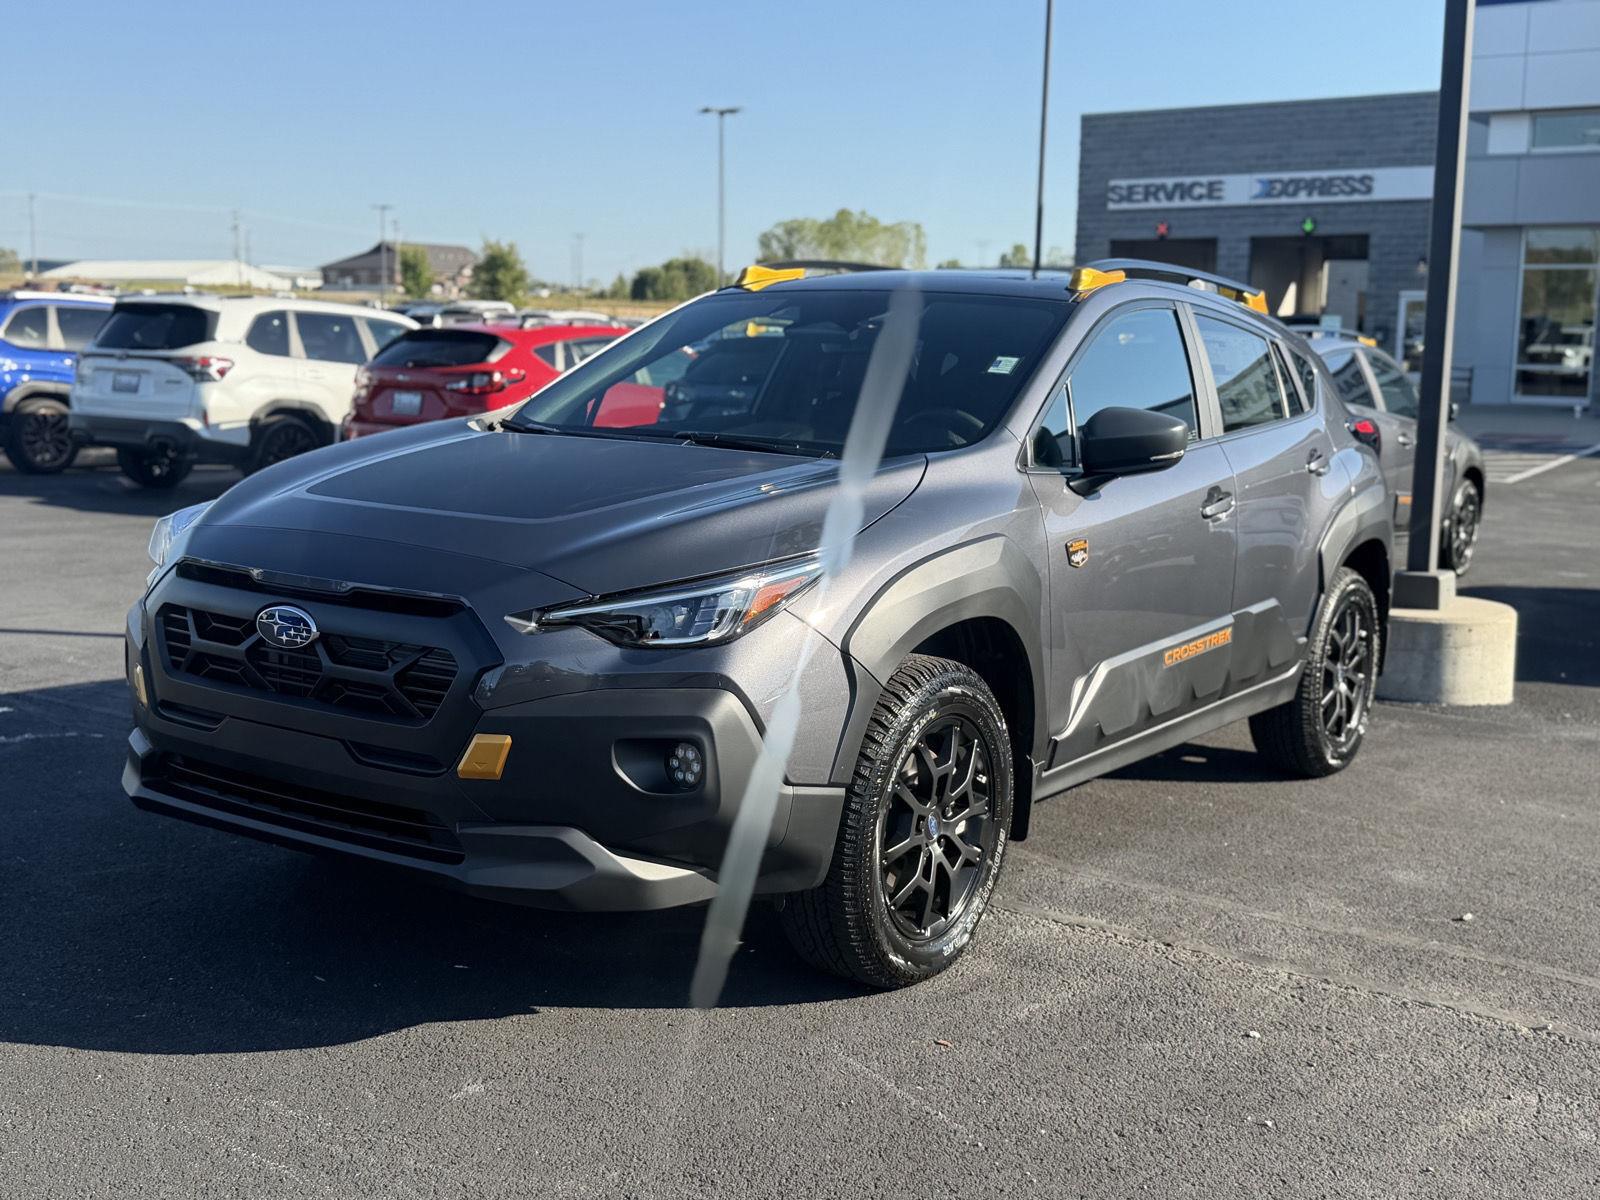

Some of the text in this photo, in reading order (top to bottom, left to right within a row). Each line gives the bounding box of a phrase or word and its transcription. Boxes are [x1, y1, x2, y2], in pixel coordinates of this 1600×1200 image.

[1107, 175, 1374, 203] SERVICE EXPRESS
[1163, 627, 1233, 667] CROSSTREK
